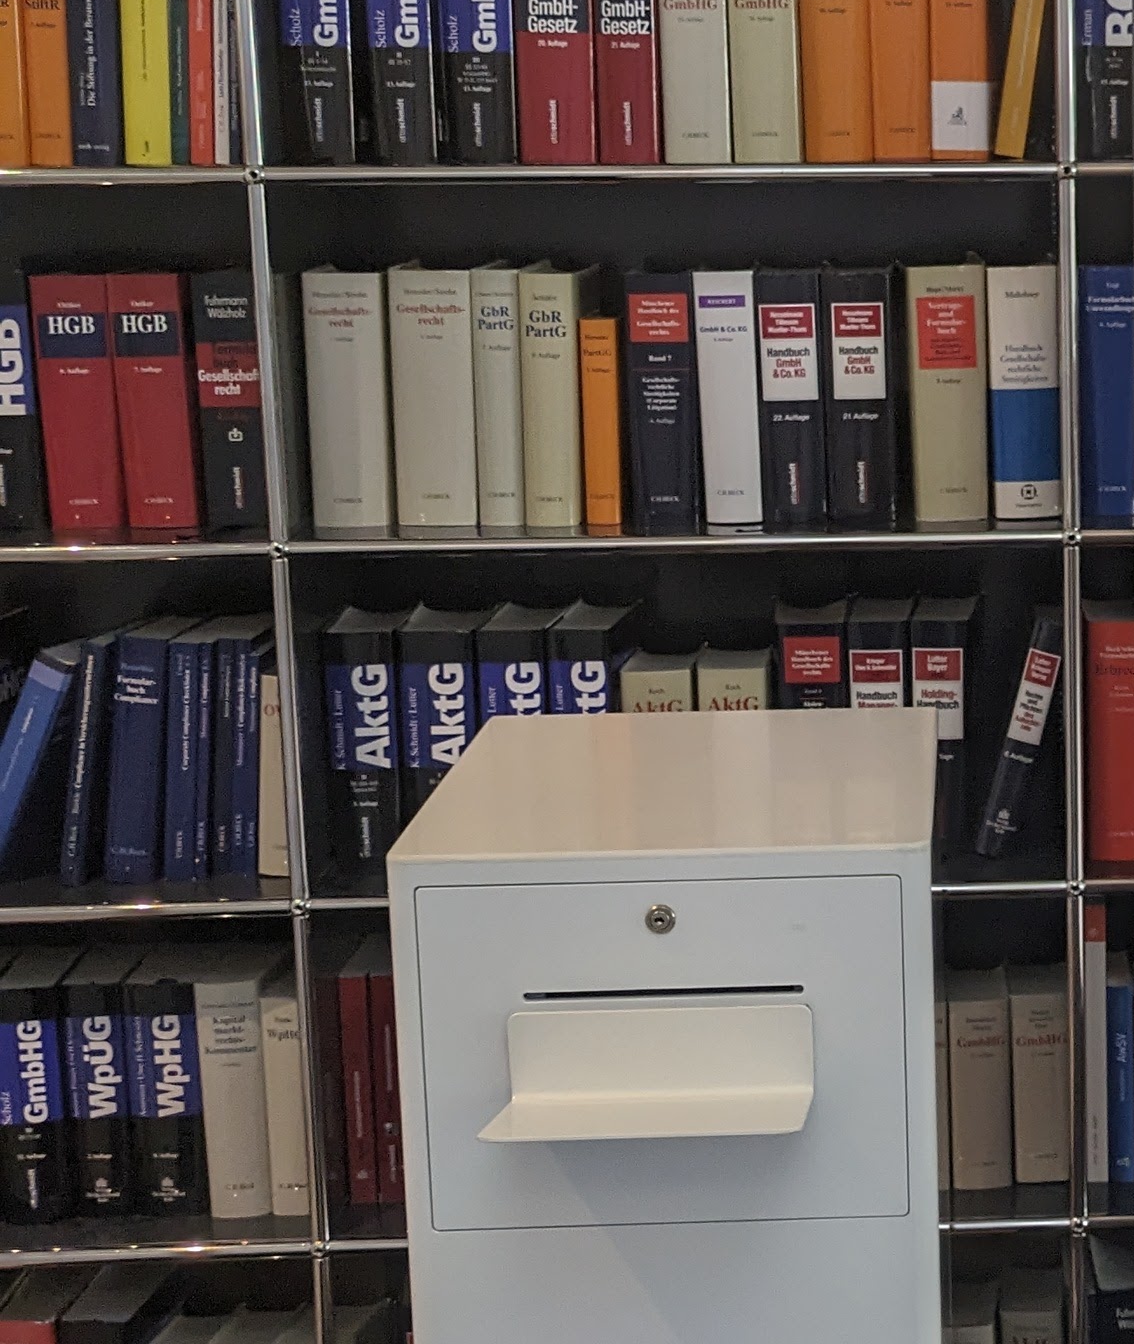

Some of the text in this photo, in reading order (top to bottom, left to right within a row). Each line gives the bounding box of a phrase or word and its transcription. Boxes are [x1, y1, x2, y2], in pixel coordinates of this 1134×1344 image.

[601, 0, 650, 17] GmbH-
[289, 8, 300, 47] Scholz
[374, 9, 387, 48] Scholz
[527, 17, 578, 34] Gesetz
[601, 18, 650, 35] Gesetz
[1082, 9, 1092, 46] Erman
[448, 15, 459, 53] Scholz
[84, 56, 97, 89] Stiftung
[480, 307, 510, 318] GbR
[528, 310, 562, 323] GbR
[48, 317, 96, 334] HGB
[122, 314, 168, 333] HGB
[329, 318, 353, 328] recht
[418, 316, 444, 326] recht
[478, 319, 514, 331] PartG
[525, 325, 567, 338] PartG
[700, 325, 718, 333] GmbH
[726, 325, 736, 333] Co.
[766, 347, 810, 358] Handbuch
[839, 346, 879, 355] Handbuch
[776, 358, 802, 368] GmbH
[847, 356, 871, 365] GmbH
[772, 369, 806, 378] & Co. KG
[844, 365, 875, 374] & Co. KG
[214, 384, 241, 395] recht
[784, 413, 810, 422] Auflage
[853, 412, 879, 420] Auflage
[487, 686, 496, 713] Lutter
[856, 691, 897, 701] Handbuch
[921, 689, 957, 699] Holding-
[709, 697, 758, 711] AktG
[916, 700, 959, 709] Handbuch
[352, 664, 391, 769] AktG
[428, 663, 466, 765] AktG
[409, 720, 420, 756] Schmidt
[16, 1020, 48, 1124] GmbHG
[83, 1016, 122, 1119] WpÜG
[152, 1015, 190, 1117] WpHG
